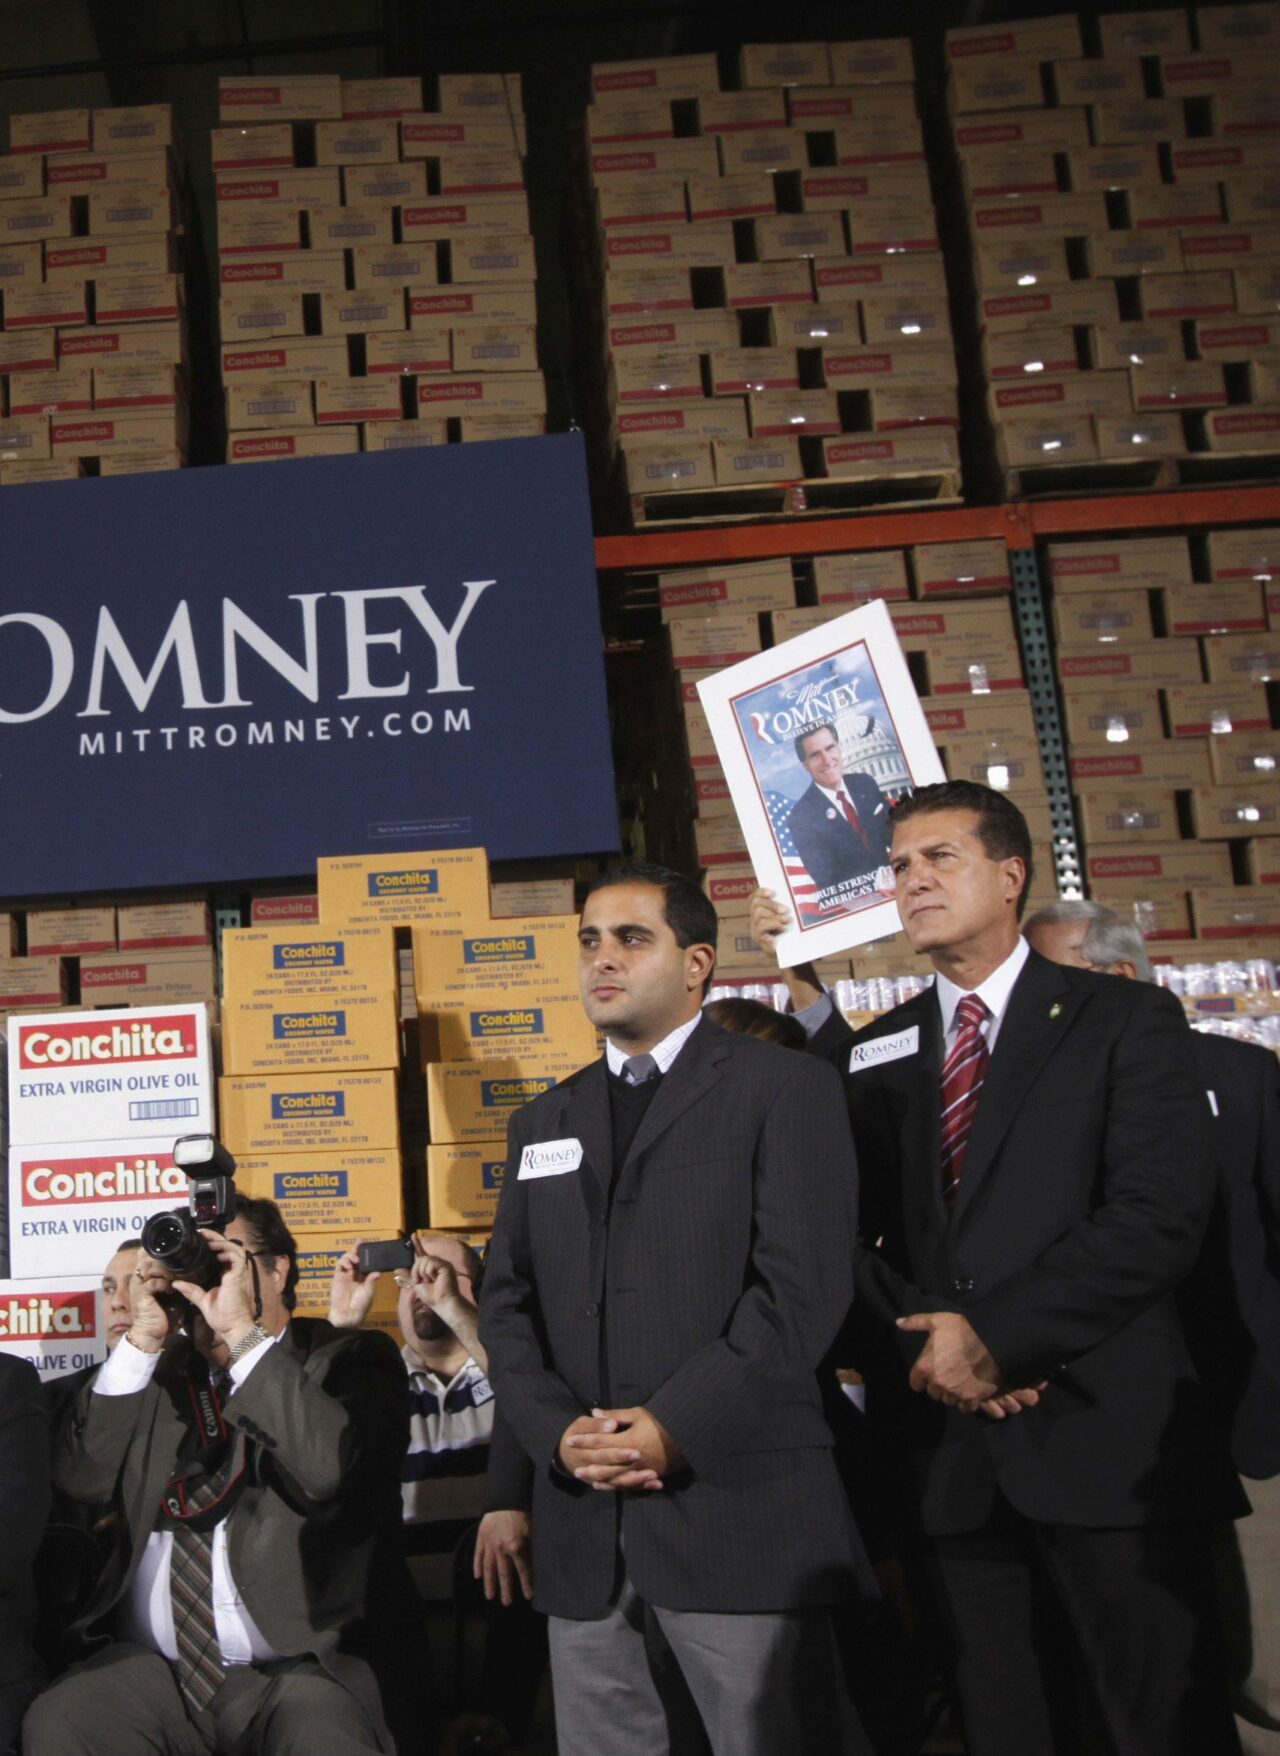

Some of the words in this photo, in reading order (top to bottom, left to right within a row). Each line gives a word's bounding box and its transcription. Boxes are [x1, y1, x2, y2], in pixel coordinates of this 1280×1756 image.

[220, 184, 273, 196] Conchita
[406, 209, 458, 222] Conchita
[49, 251, 101, 263] Conchita
[224, 266, 277, 278] Conchita
[412, 298, 467, 310] Conchita
[61, 338, 113, 351] Conchita
[227, 353, 280, 366] Conchita
[422, 386, 475, 398] Conchita
[622, 414, 678, 428] Conchita
[55, 425, 108, 439] Conchita
[235, 440, 289, 454] Conchita
[662, 586, 720, 602] Conchita
[750, 677, 861, 744] ROMNEY
[79, 708, 472, 755] MITTROMNEY.COM
[376, 872, 431, 887] Conchita
[256, 902, 312, 916] Conchita
[281, 944, 337, 959] Conchita
[472, 939, 528, 954] Conchita
[83, 968, 140, 982] Conchita
[281, 1013, 338, 1029] Conchita
[479, 1011, 535, 1026] Conchita
[24, 1023, 184, 1063] Conchita
[854, 1036, 913, 1061] ROMNEY
[20, 1082, 66, 1098] EXTRA
[70, 1078, 122, 1094] VIRGIN
[127, 1074, 170, 1091] OLIVE
[174, 1072, 200, 1088] OIL
[490, 1080, 549, 1096] Conchita
[279, 1093, 337, 1109] Conchita
[524, 1147, 580, 1169] ROMNEY
[25, 1159, 189, 1201] Conchita
[282, 1173, 340, 1188] Conchita
[21, 1221, 69, 1238] EXTRA
[73, 1217, 126, 1234] VIRGIN
[199, 1391, 218, 1437] Canon
